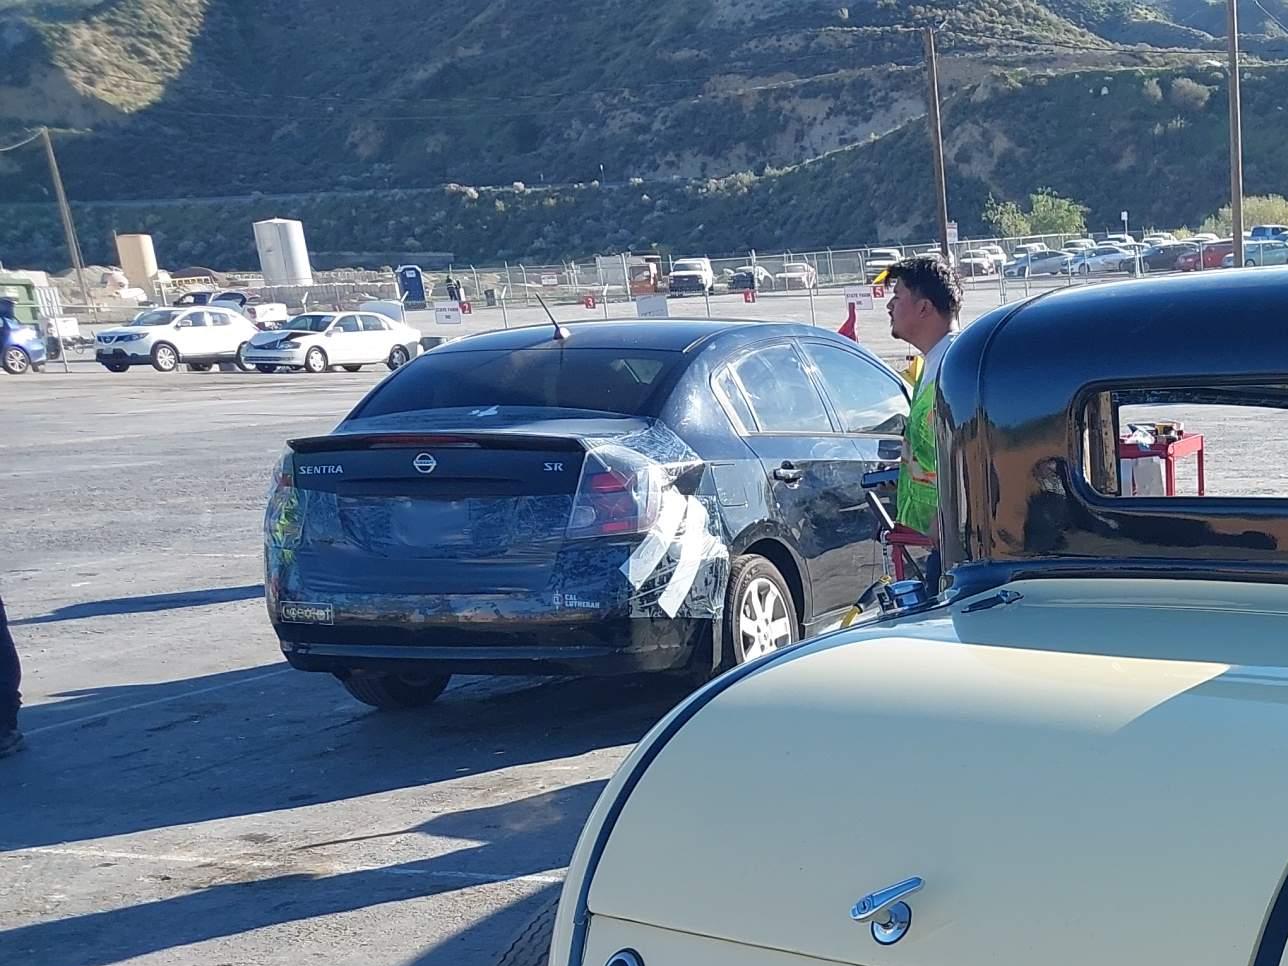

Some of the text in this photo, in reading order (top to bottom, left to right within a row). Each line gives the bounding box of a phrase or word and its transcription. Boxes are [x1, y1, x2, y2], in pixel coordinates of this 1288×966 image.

[875, 286, 882, 297] 5
[587, 297, 594, 308] 3
[463, 303, 470, 313] 2
[299, 465, 343, 475] SENTRA
[543, 462, 564, 472] SR
[565, 601, 600, 609] LUTHERAN
